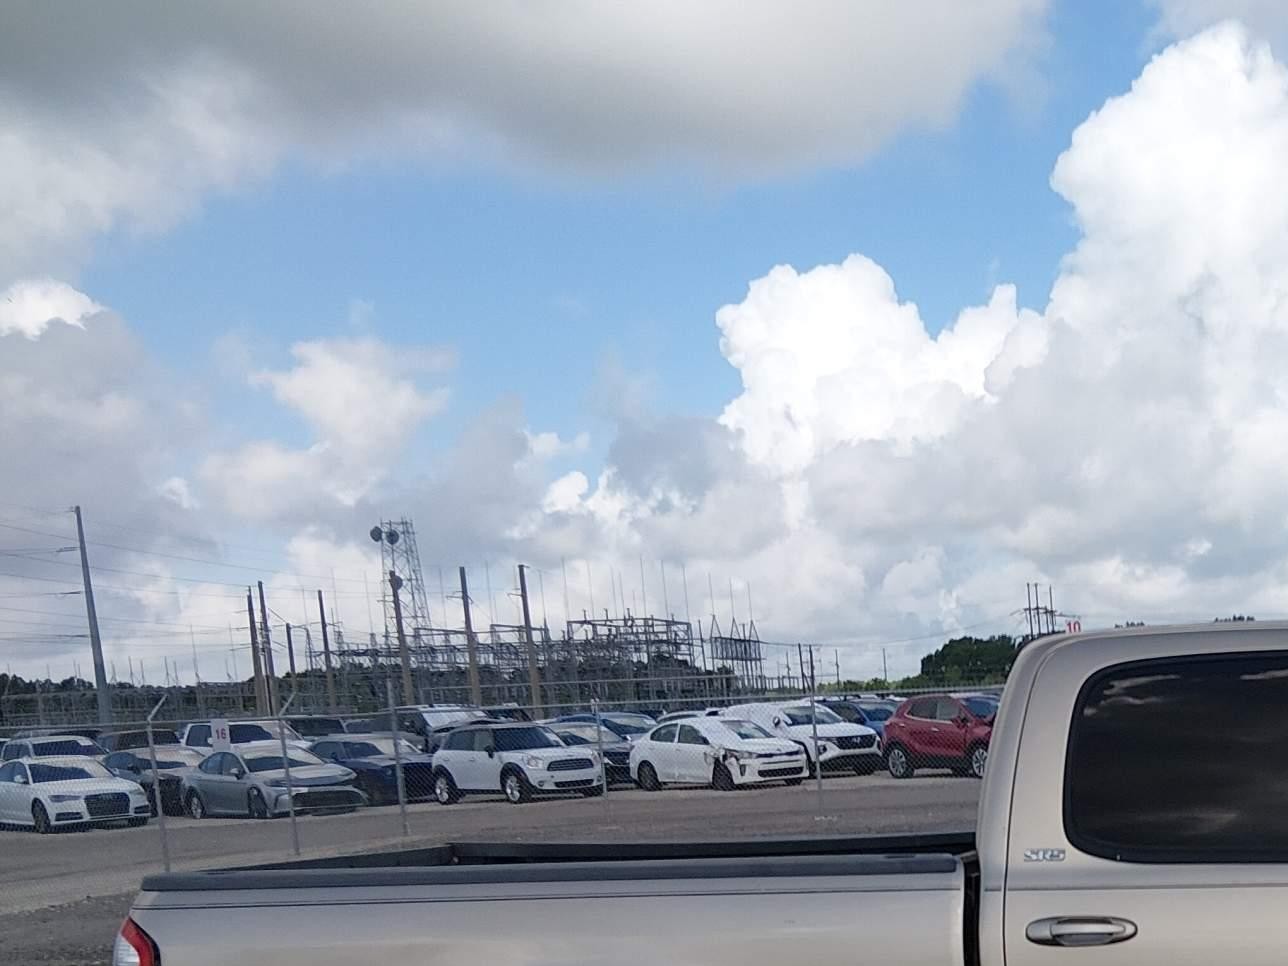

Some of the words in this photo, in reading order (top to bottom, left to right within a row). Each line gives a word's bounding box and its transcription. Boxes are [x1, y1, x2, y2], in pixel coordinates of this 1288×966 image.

[1066, 620, 1082, 633] 10
[215, 728, 227, 740] 16
[1023, 849, 1066, 862] SR5
